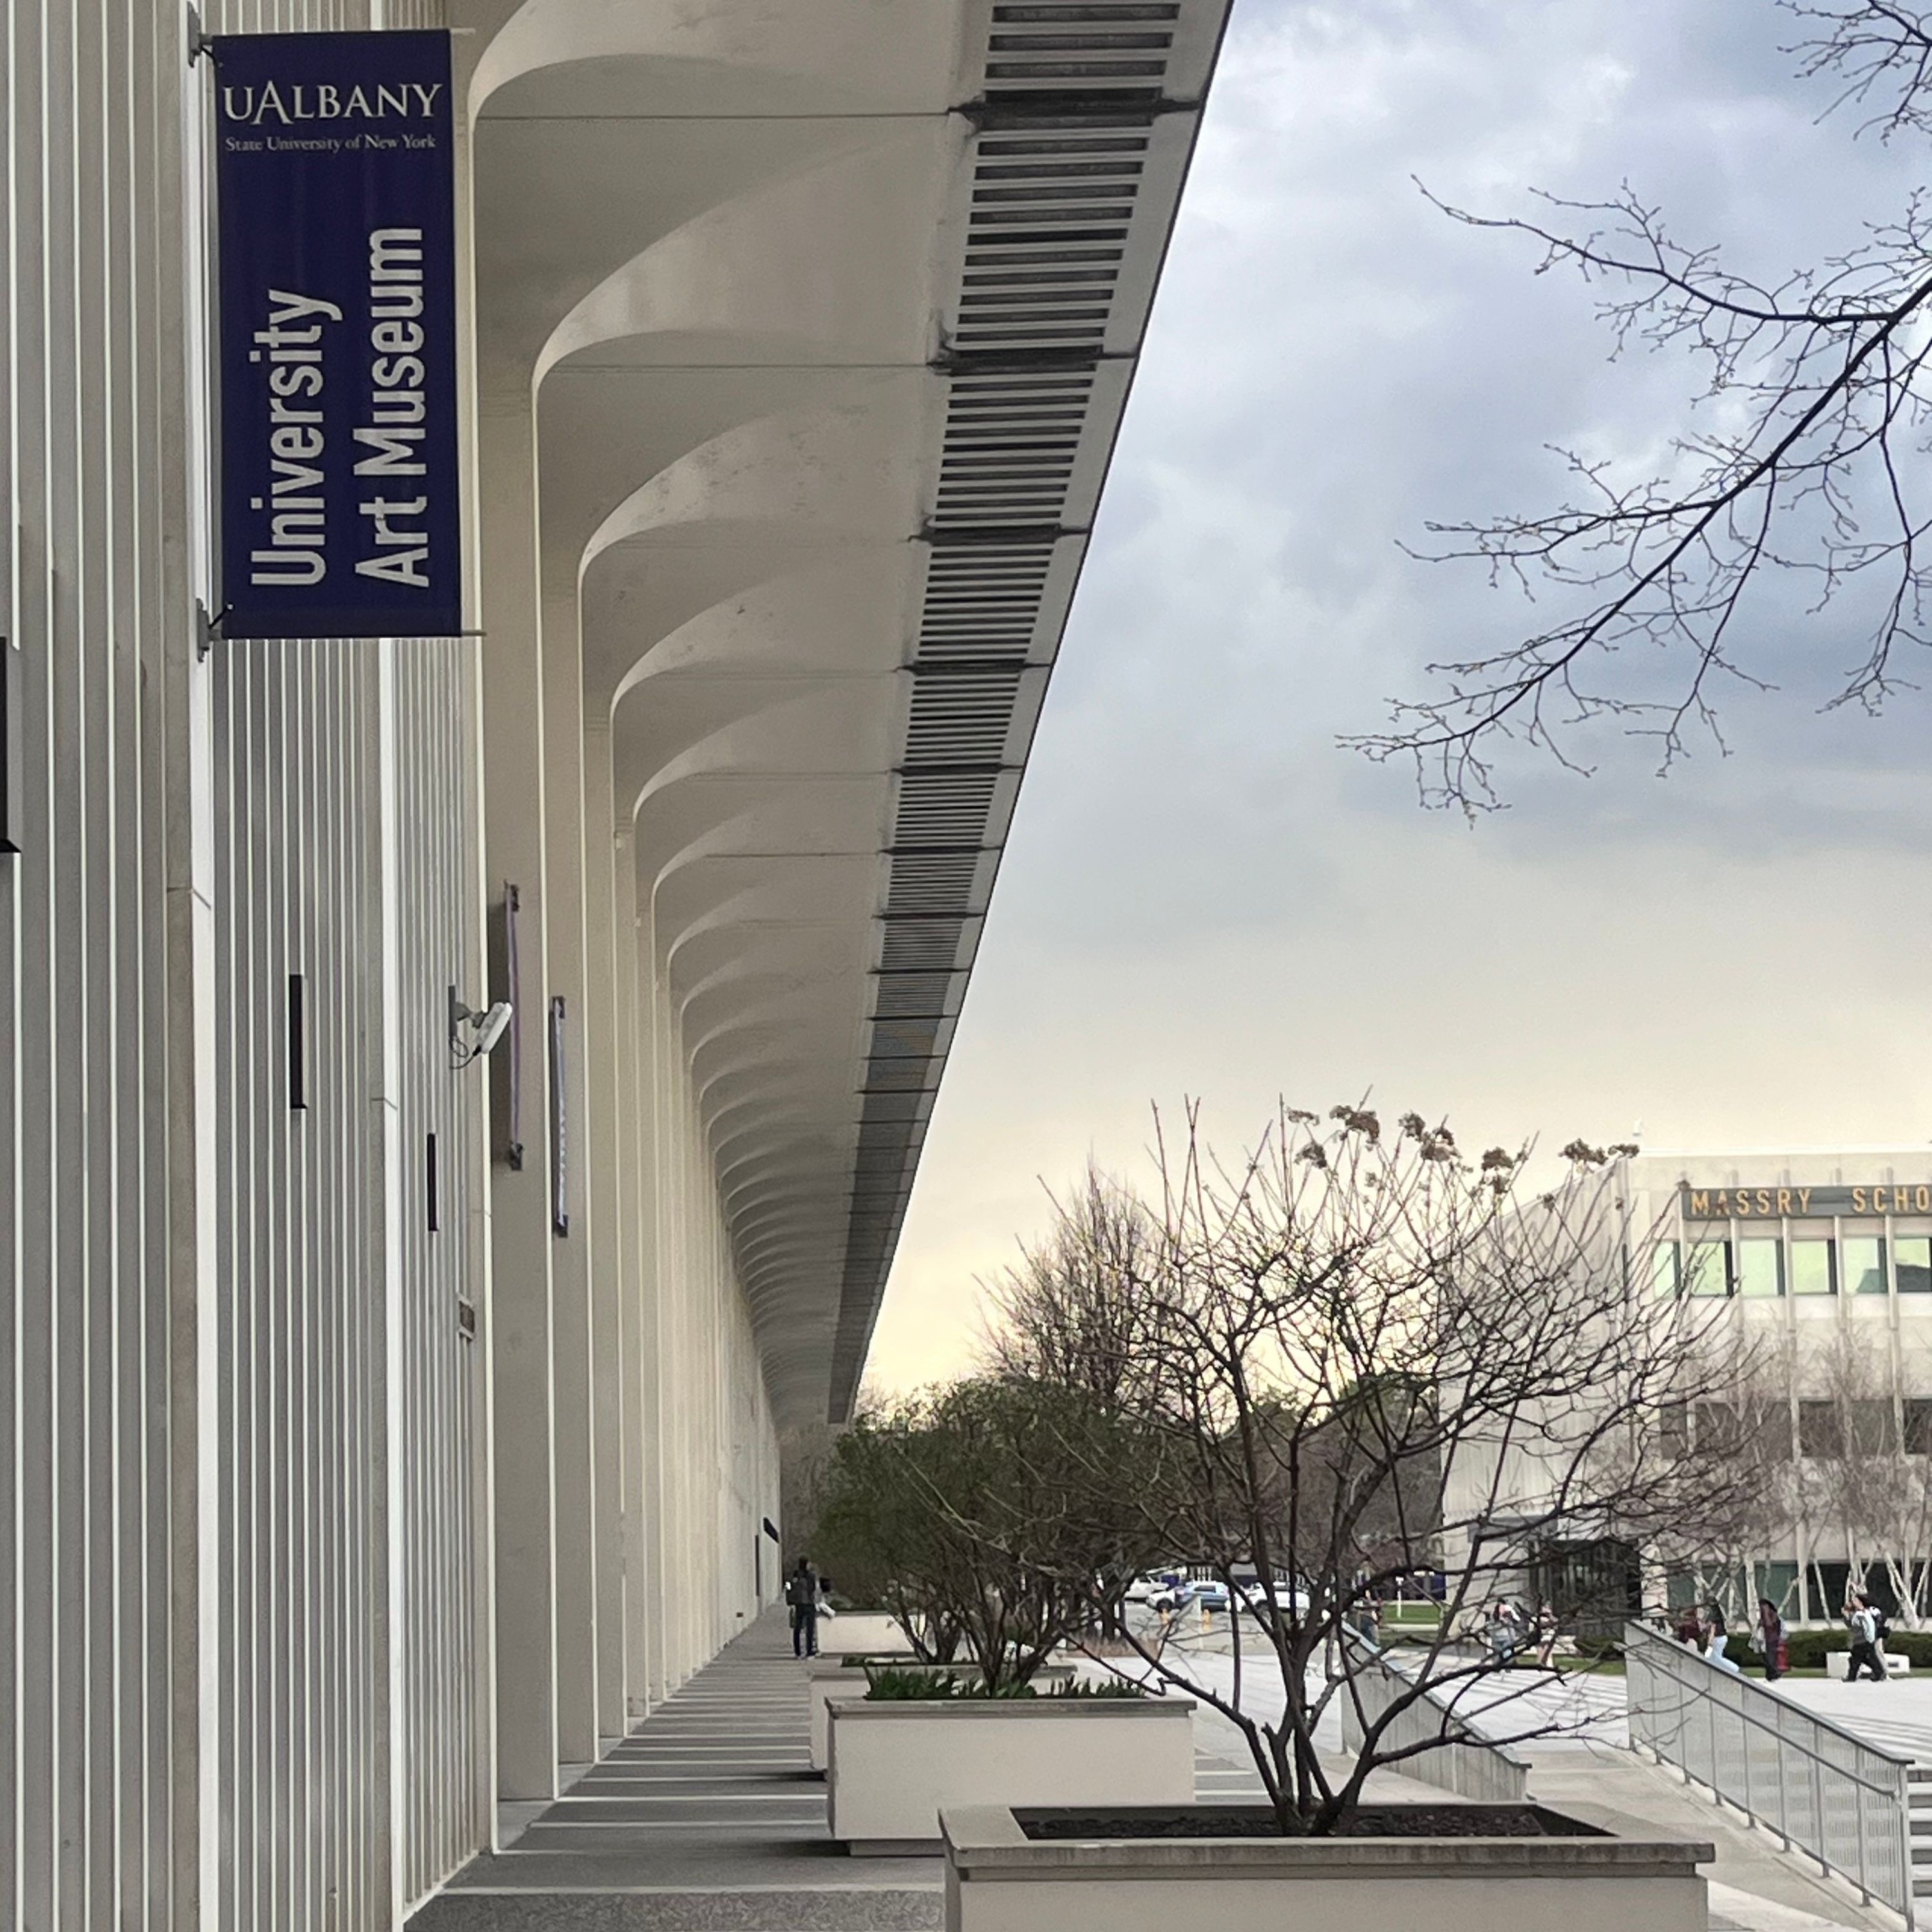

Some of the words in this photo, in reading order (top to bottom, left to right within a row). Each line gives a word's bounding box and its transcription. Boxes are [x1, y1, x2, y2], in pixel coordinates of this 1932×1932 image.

[223, 80, 442, 125] UALBANY
[225, 137, 263, 151] State
[267, 136, 341, 154] University
[345, 134, 361, 149] of
[365, 134, 398, 149] New
[402, 133, 436, 149] York
[352, 229, 426, 476] Museum
[249, 289, 343, 585] University
[354, 496, 430, 588] Art
[1690, 1188, 1812, 1216] MASSRY
[1852, 1186, 1930, 1212] SCHO
